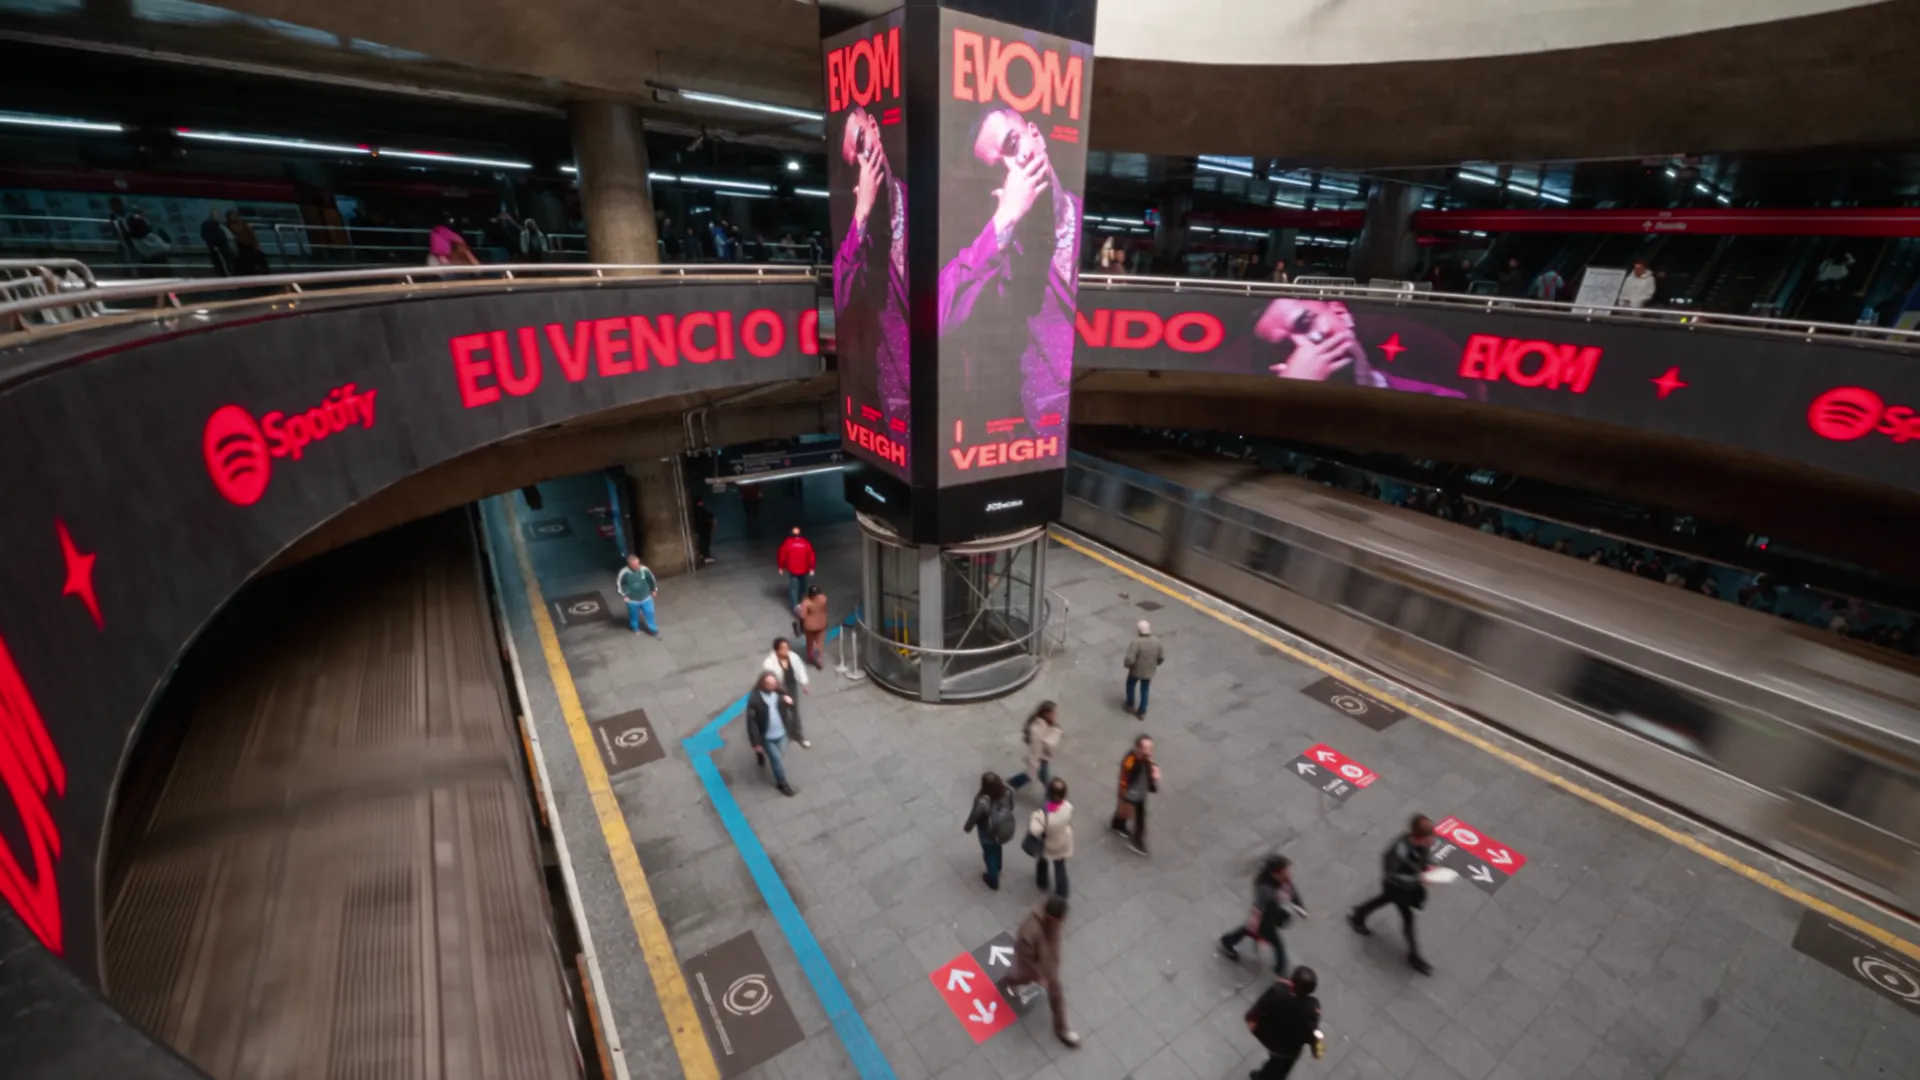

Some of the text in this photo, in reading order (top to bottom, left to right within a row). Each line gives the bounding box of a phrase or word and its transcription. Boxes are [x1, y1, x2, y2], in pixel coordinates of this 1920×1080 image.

[828, 27, 900, 112] EVOM
[953, 28, 1083, 120] EVOM
[450, 327, 542, 410] EU
[544, 311, 735, 383] VENCI
[741, 309, 785, 358] O
[1459, 332, 1604, 394] EVOM
[261, 382, 378, 460] Spotify
[844, 419, 905, 467] VEIGH
[949, 436, 1058, 470] VEIGH
